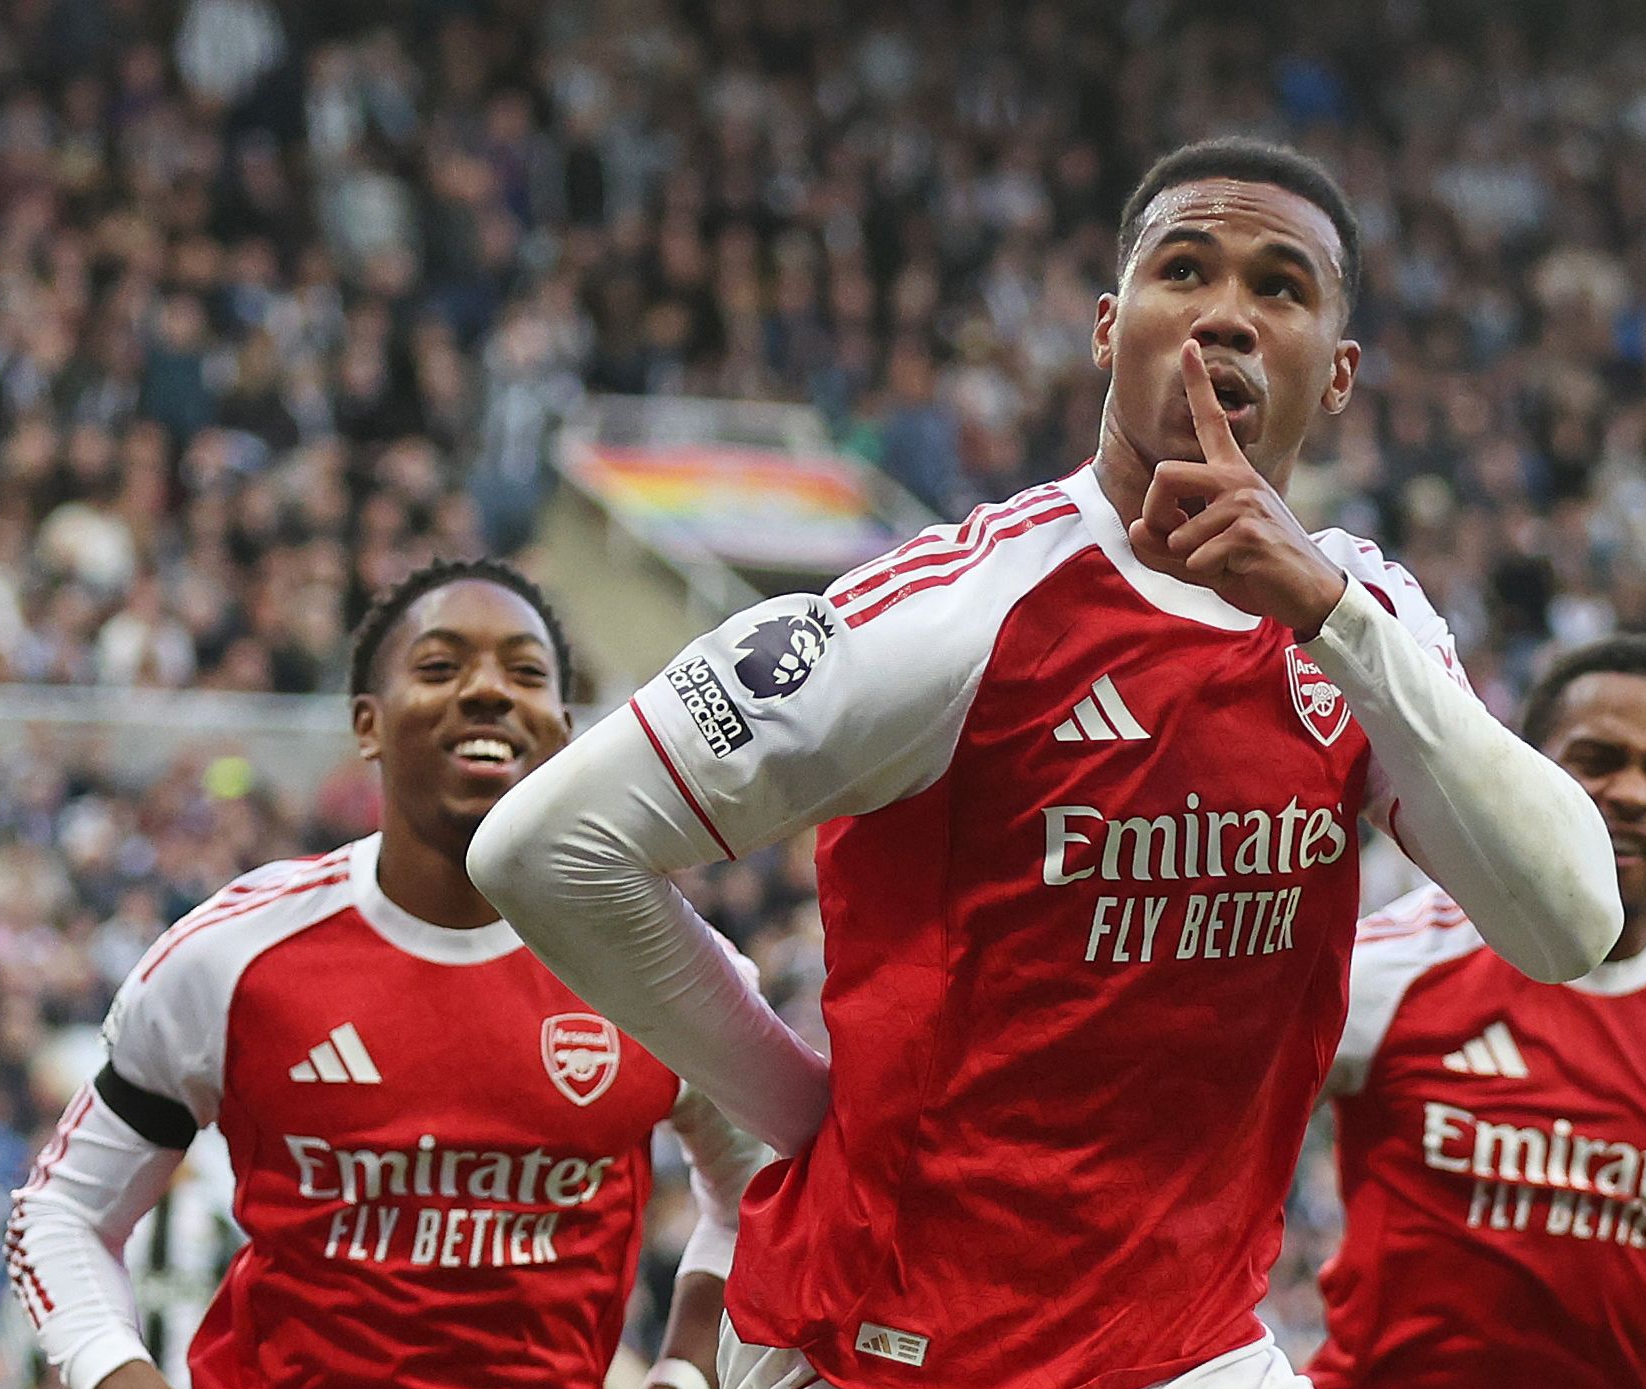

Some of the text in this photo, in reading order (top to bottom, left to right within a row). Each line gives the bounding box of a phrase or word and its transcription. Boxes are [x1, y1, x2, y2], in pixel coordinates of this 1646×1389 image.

[665, 663, 732, 758] for racism
[687, 656, 743, 740] No room
[1041, 792, 1347, 886] Emirates
[1084, 886, 1302, 963] FLY BETTER
[283, 1134, 615, 1207] Emirates
[324, 1204, 559, 1268] FLY BETTER
